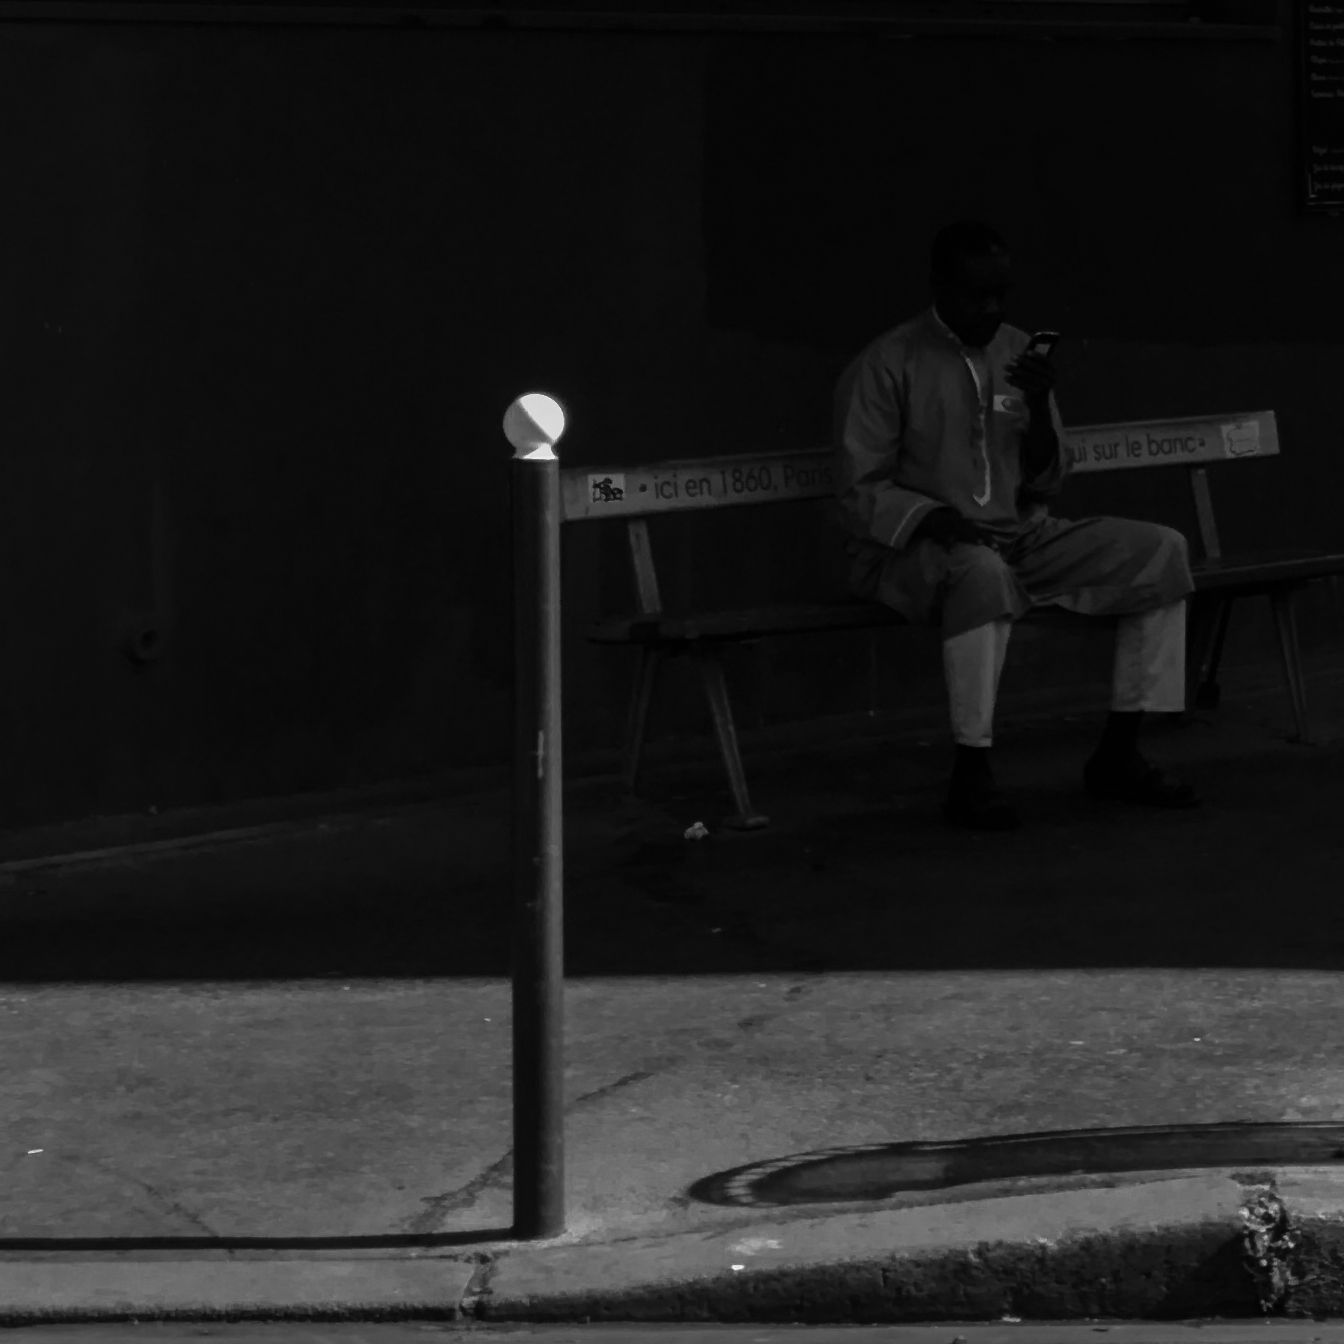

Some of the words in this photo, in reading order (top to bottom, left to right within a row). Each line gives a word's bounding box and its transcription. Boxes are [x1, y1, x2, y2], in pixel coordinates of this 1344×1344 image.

[1093, 440, 1121, 465] sur
[1124, 435, 1143, 459] le
[654, 473, 679, 500] ici
[685, 476, 713, 498] en
[719, 465, 779, 496] 1860,
[782, 463, 834, 488] Paris
